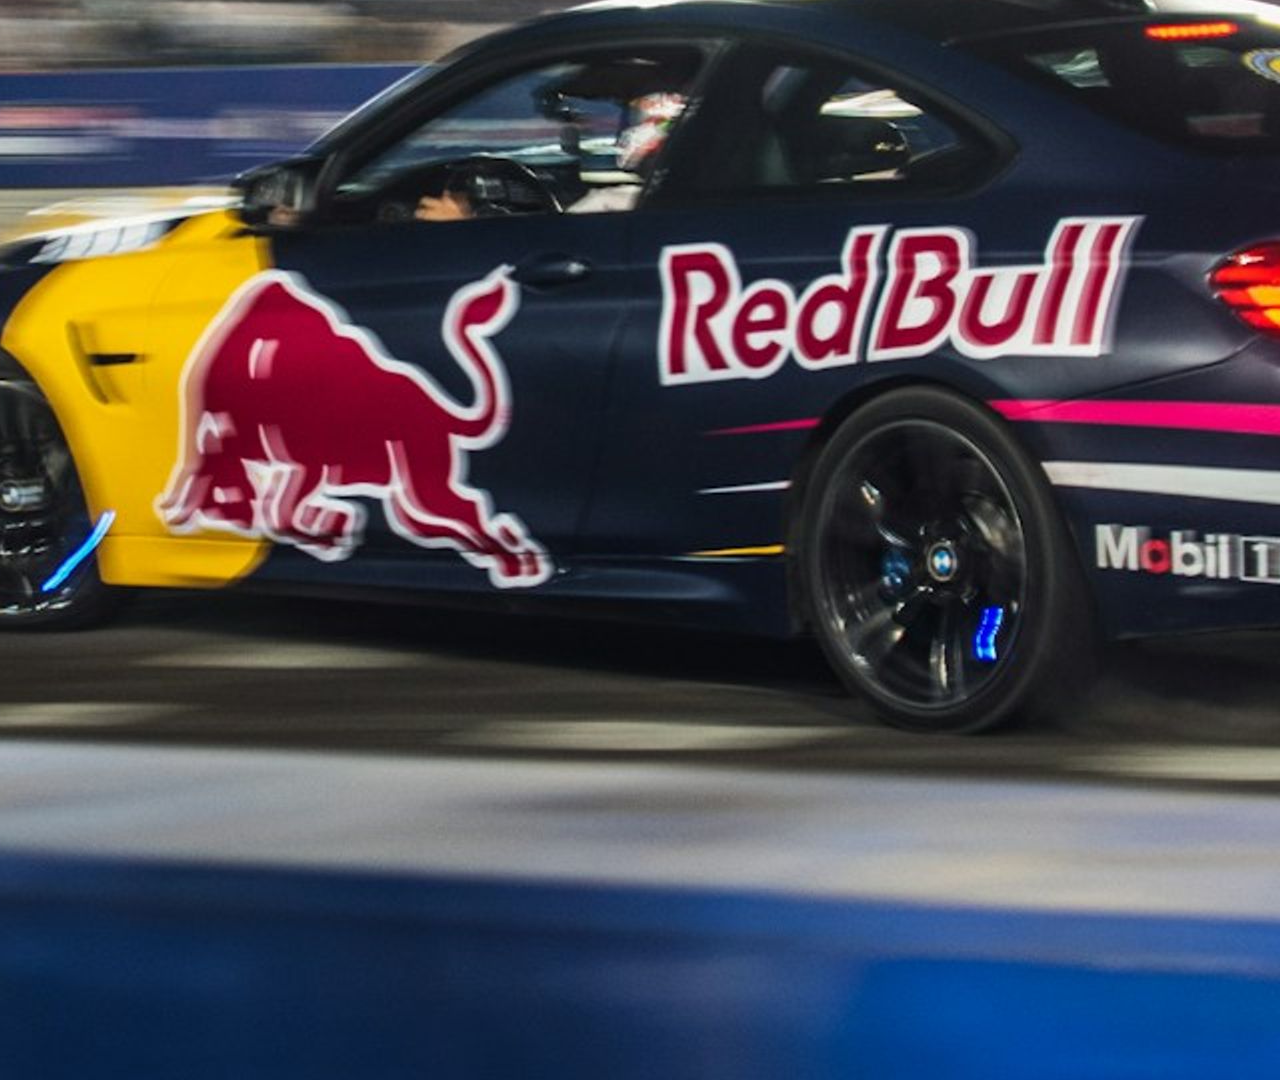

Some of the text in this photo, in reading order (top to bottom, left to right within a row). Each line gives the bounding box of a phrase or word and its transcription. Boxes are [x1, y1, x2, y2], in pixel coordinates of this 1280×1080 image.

[659, 216, 1142, 386] Red Bull
[1095, 524, 1232, 579] Mobil
